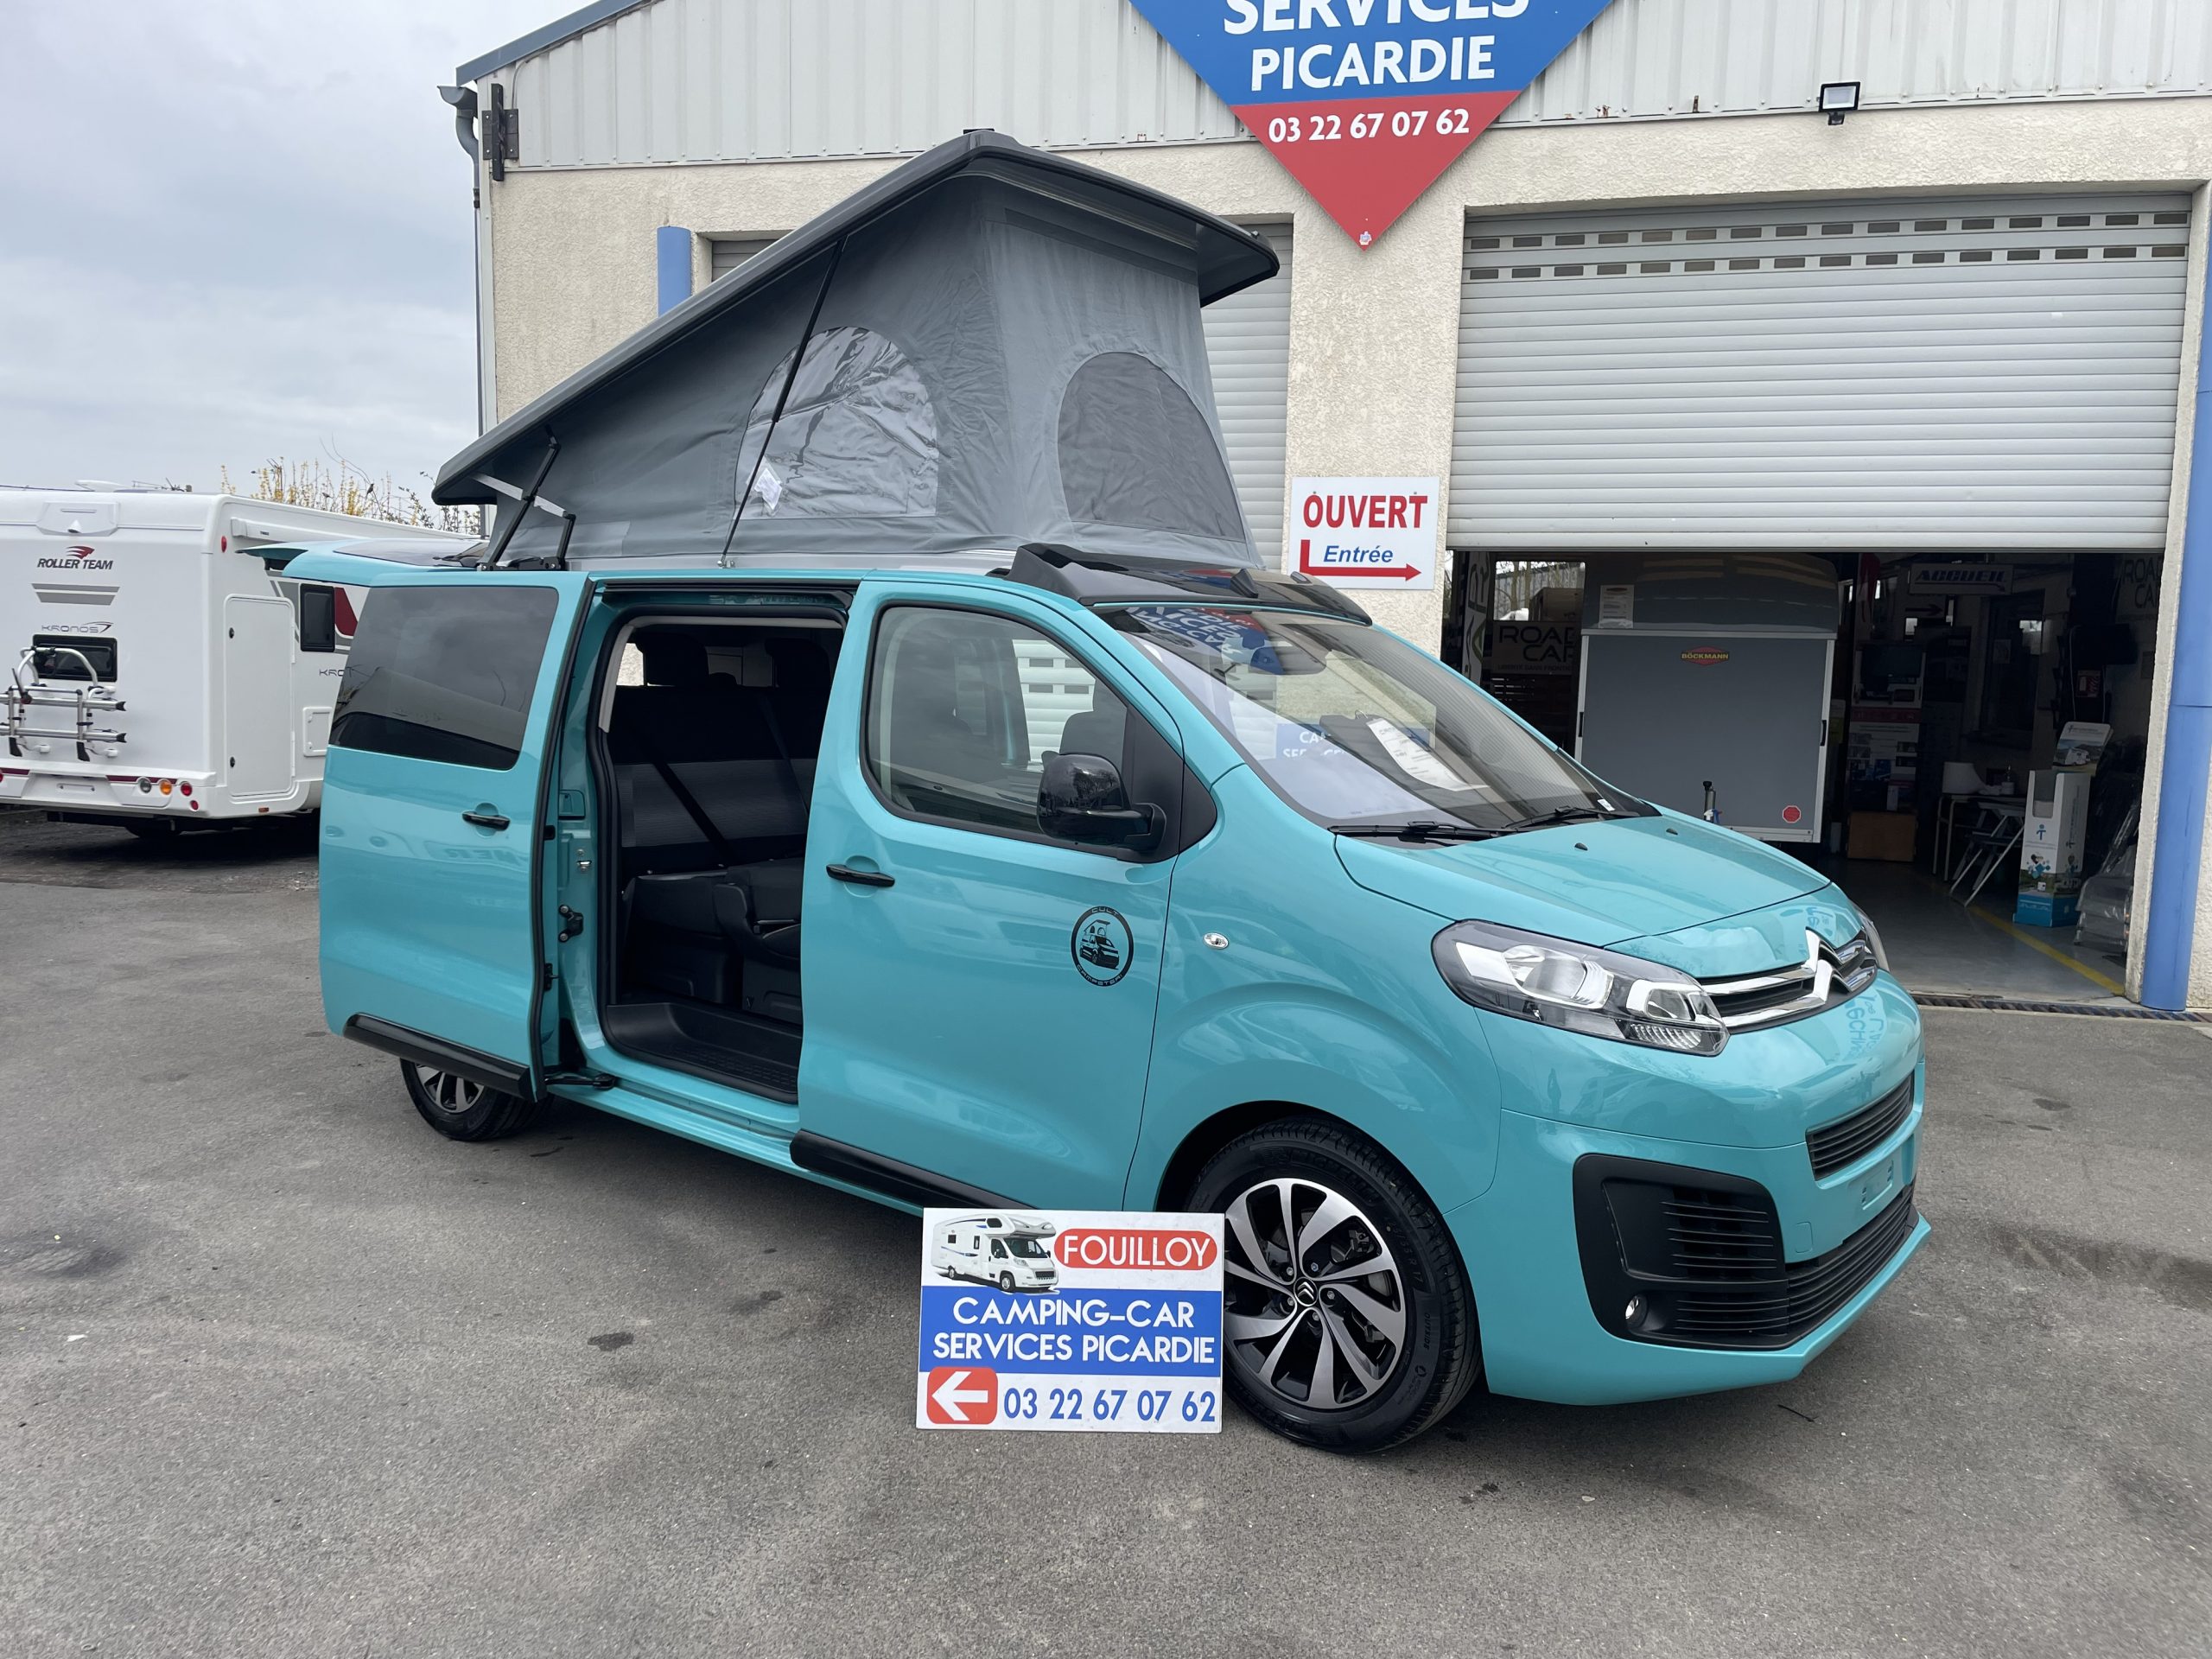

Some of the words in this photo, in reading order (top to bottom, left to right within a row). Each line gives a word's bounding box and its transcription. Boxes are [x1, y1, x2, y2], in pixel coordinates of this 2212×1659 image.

[1251, 35, 1495, 92] PICARDIE
[1268, 118, 1301, 143] 03
[1309, 115, 1341, 141] 22
[1350, 112, 1384, 139] 67
[1391, 110, 1428, 137] 07
[1436, 108, 1469, 135] 62
[1303, 494, 1428, 528] OUVERT
[37, 558, 80, 569] ROLLER
[83, 560, 113, 569] TEAM
[1324, 545, 1394, 563] Entrée
[1064, 1236, 1211, 1267] FOUILLOY
[953, 1297, 1195, 1328] CAMPING-CAR
[932, 1332, 1072, 1361] SERVICES
[1082, 1335, 1214, 1363] PICARDIE
[1004, 1388, 1037, 1419] 03
[1049, 1389, 1082, 1420] 22
[1093, 1389, 1128, 1421] 67
[1137, 1389, 1171, 1421] 07
[1182, 1391, 1215, 1422] 62
